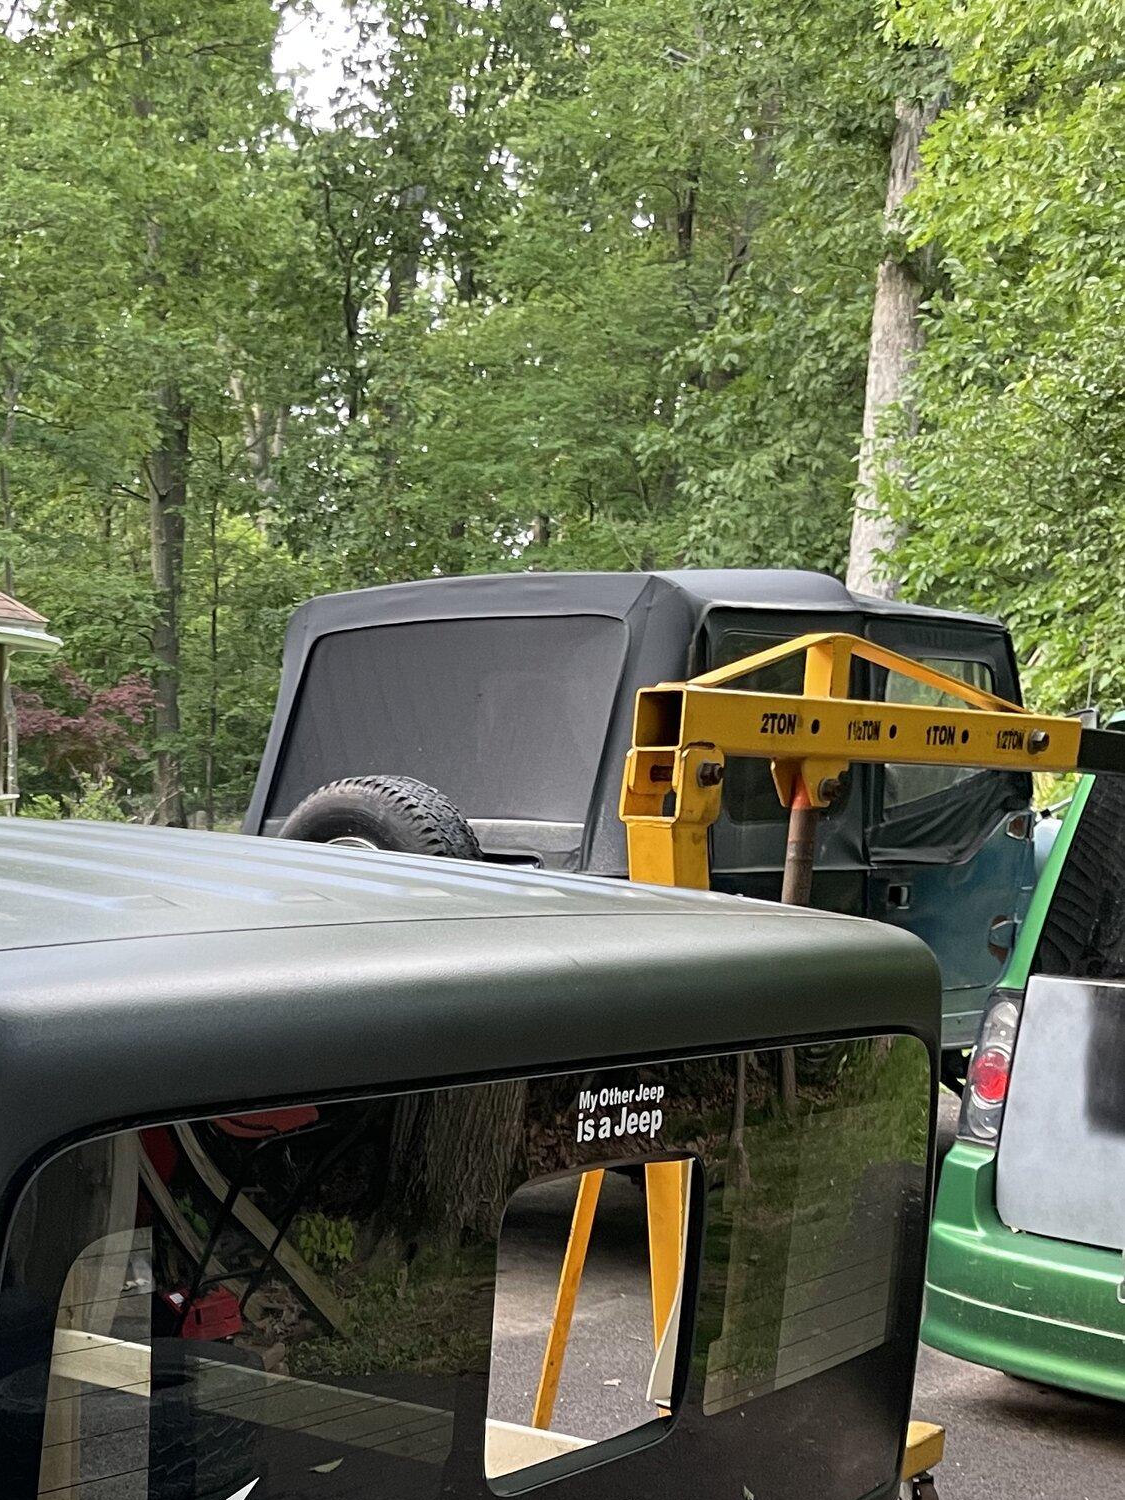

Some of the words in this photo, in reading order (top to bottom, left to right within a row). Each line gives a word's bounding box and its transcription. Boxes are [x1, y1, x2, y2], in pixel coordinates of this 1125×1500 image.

[760, 713, 797, 735] 2TON
[926, 725, 956, 746] 1TON
[578, 1091, 598, 1113] My
[599, 1087, 635, 1107] Other
[635, 1083, 665, 1103] Jeep
[576, 1113, 595, 1143] is
[598, 1117, 611, 1139] a
[614, 1107, 663, 1139] Jeep
